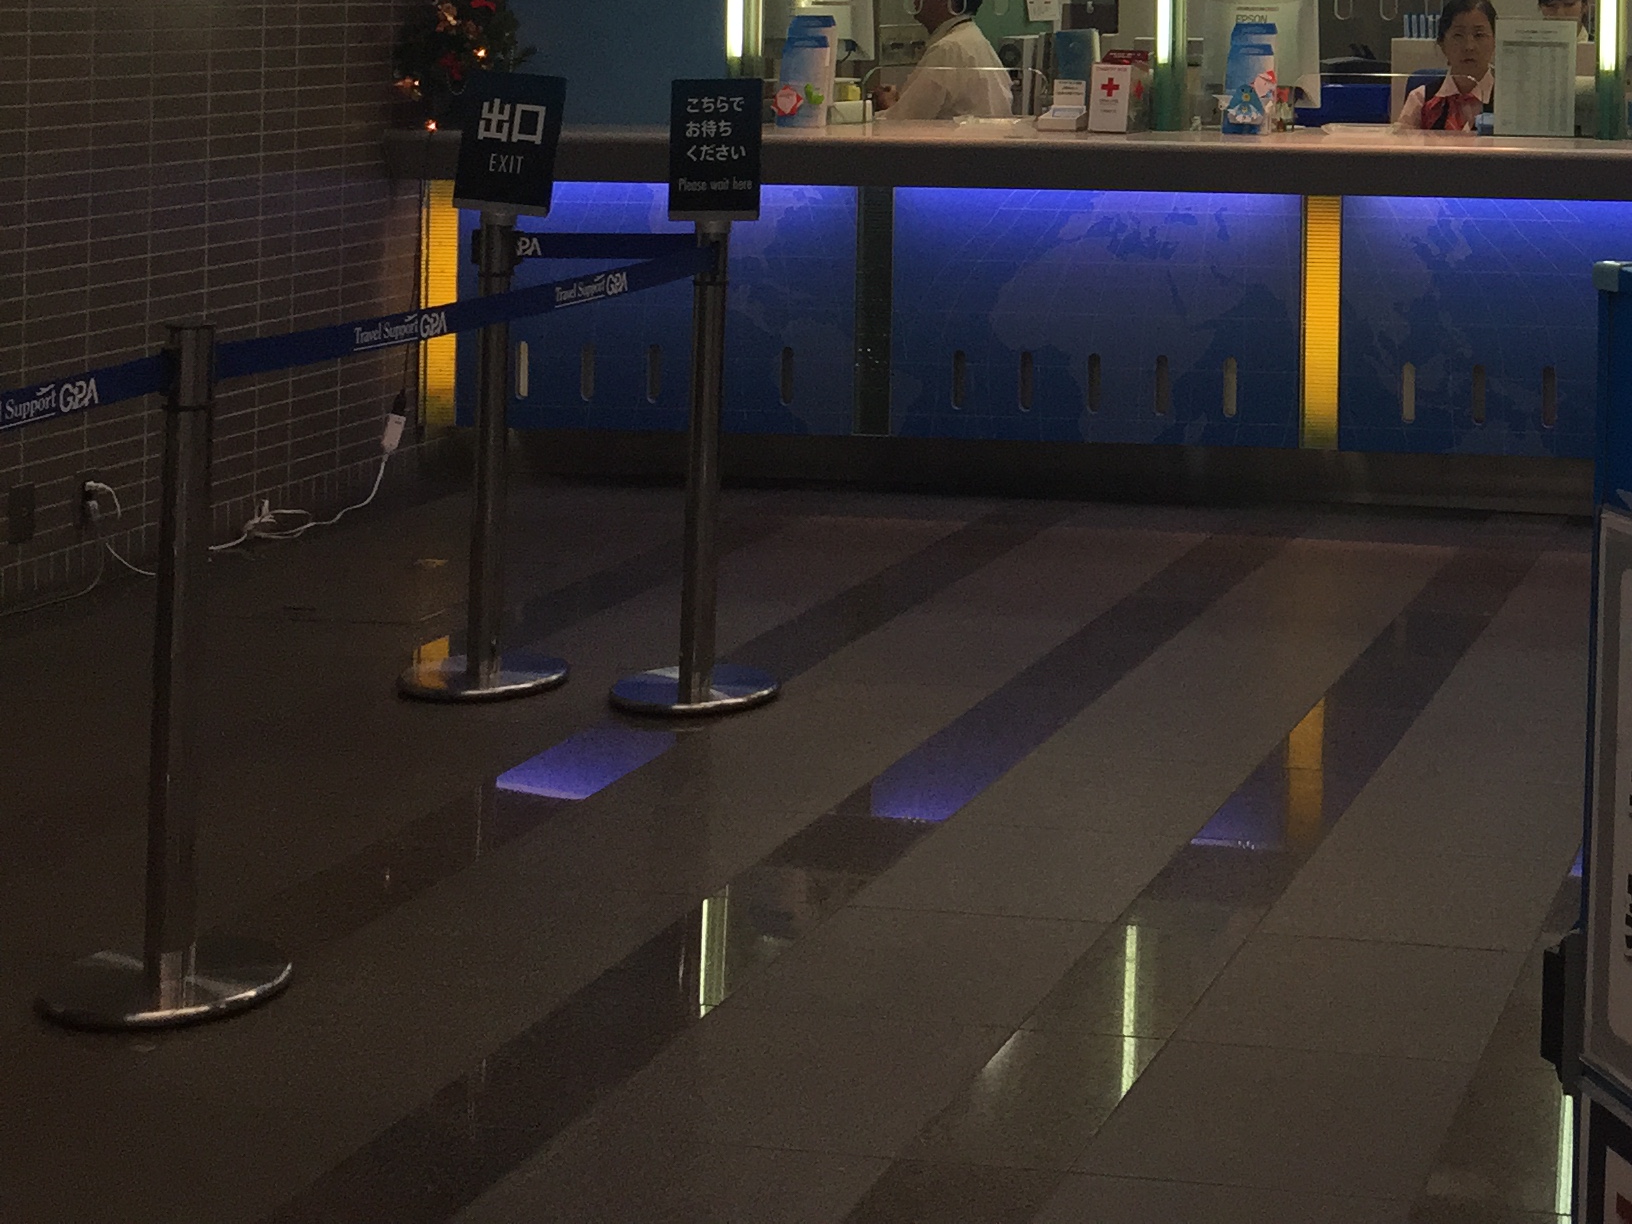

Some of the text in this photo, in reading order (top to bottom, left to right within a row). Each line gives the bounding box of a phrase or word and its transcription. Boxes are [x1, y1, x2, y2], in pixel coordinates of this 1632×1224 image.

[686, 96, 745, 113] こちらで
[477, 97, 547, 145] 出口
[685, 121, 732, 138] お待ち
[685, 144, 746, 162] ください
[489, 153, 524, 174] EXIT
[678, 177, 752, 192] Please wait here
[555, 286, 577, 302] Travel
[354, 325, 382, 344] Travel
[384, 318, 418, 340] Support
[5, 388, 56, 420] Support
